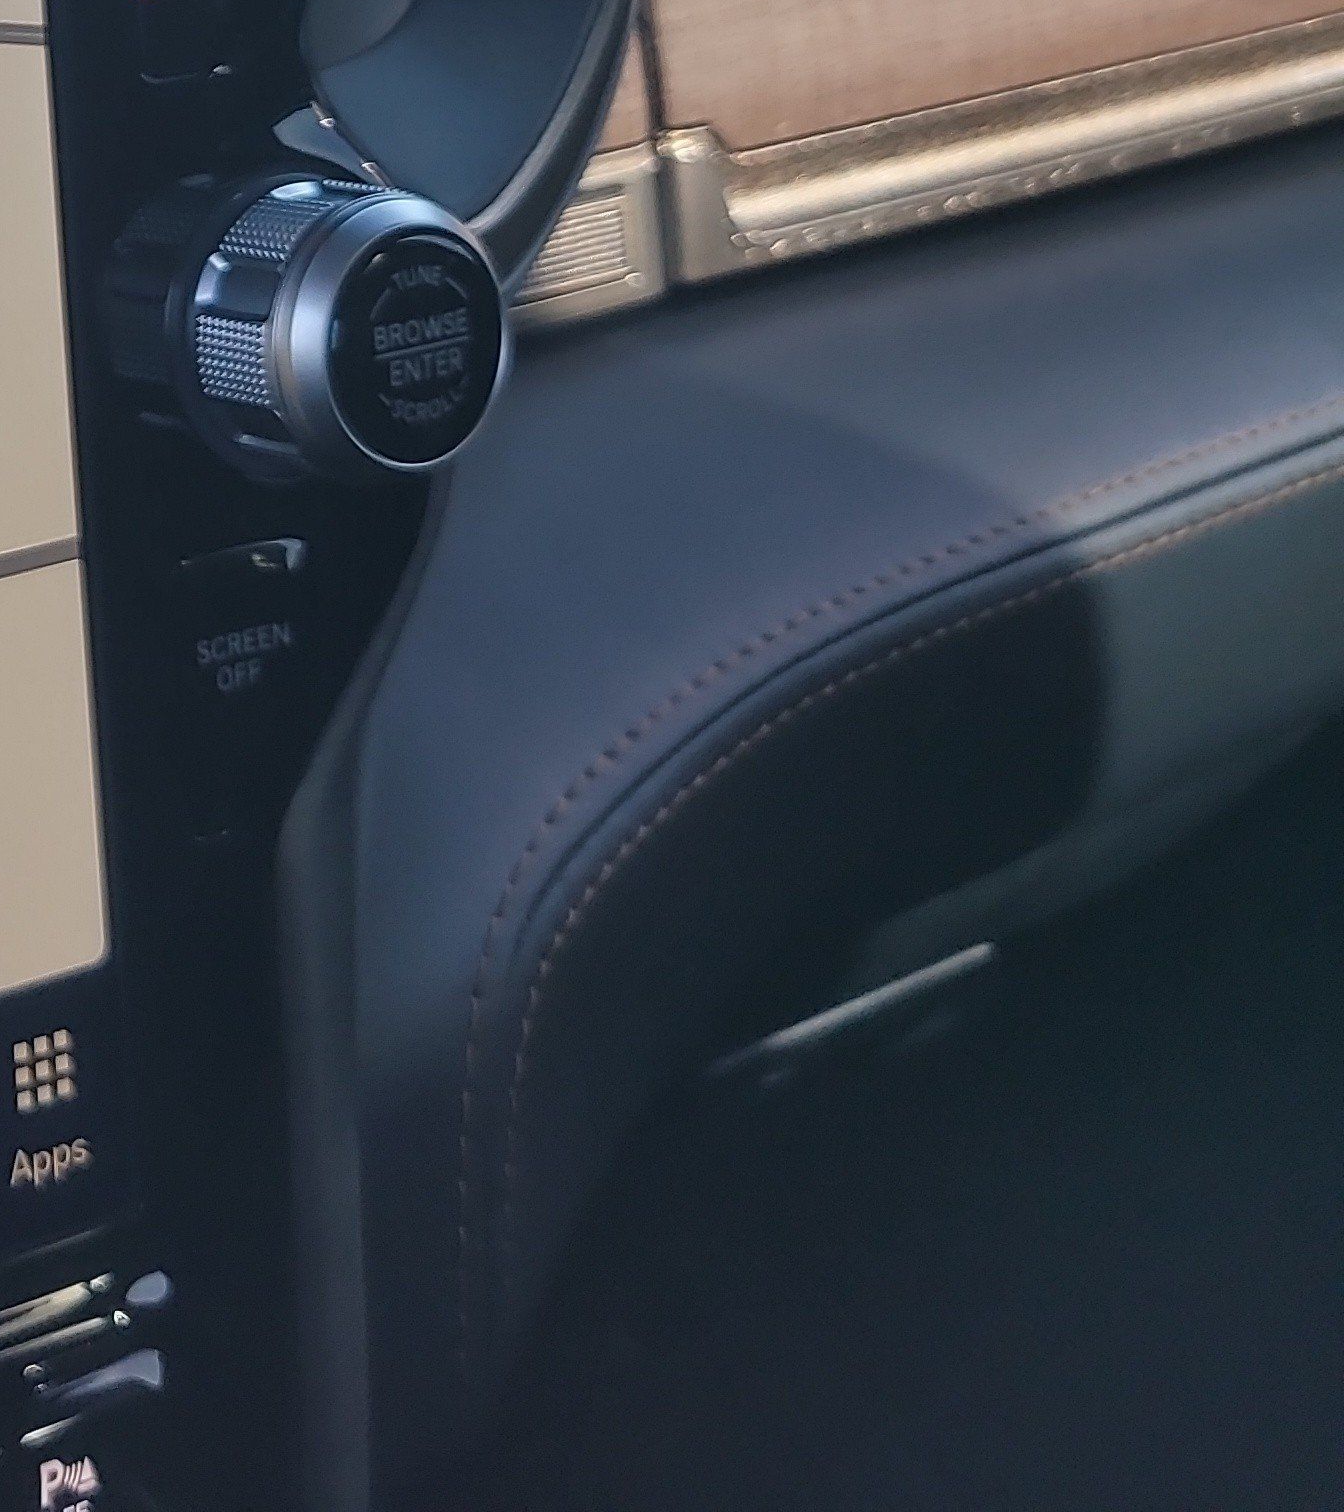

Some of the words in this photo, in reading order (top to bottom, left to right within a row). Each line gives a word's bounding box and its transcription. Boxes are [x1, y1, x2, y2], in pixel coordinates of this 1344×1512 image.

[374, 307, 469, 351] BROWSE
[389, 348, 464, 386] ENTER
[196, 622, 292, 666] SCREEN
[216, 660, 263, 691] OFF
[10, 1134, 92, 1188] Apps
